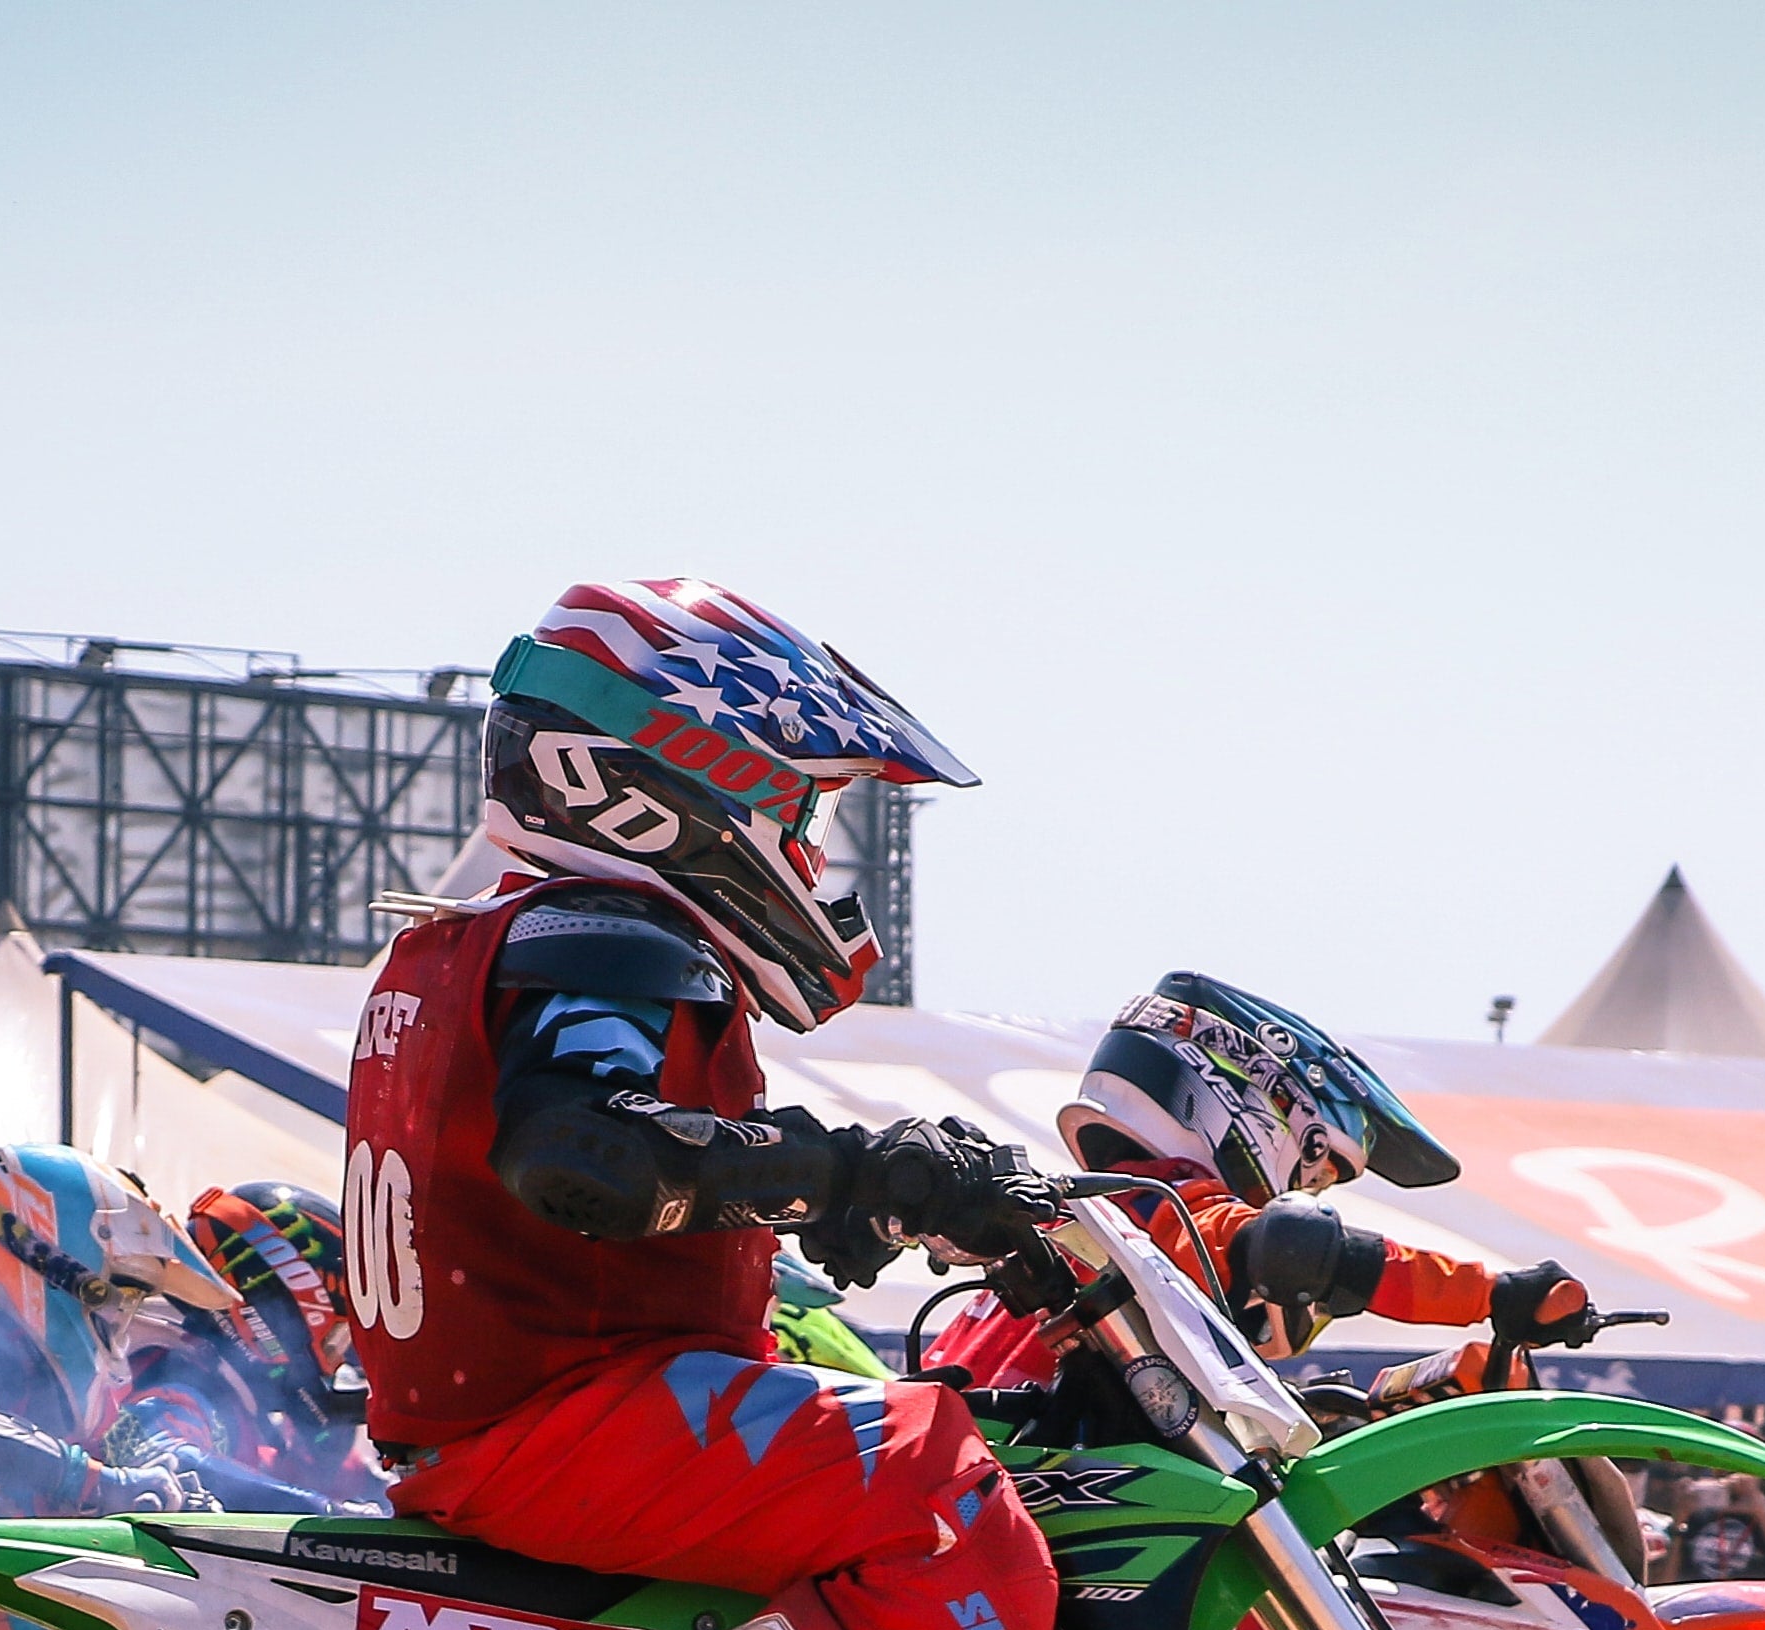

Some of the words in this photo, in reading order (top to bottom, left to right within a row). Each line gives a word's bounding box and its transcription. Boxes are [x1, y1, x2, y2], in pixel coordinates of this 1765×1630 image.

[631, 708, 813, 823] 100%
[289, 1537, 457, 1575] Kawasaki
[1075, 1587, 1145, 1602] 100
